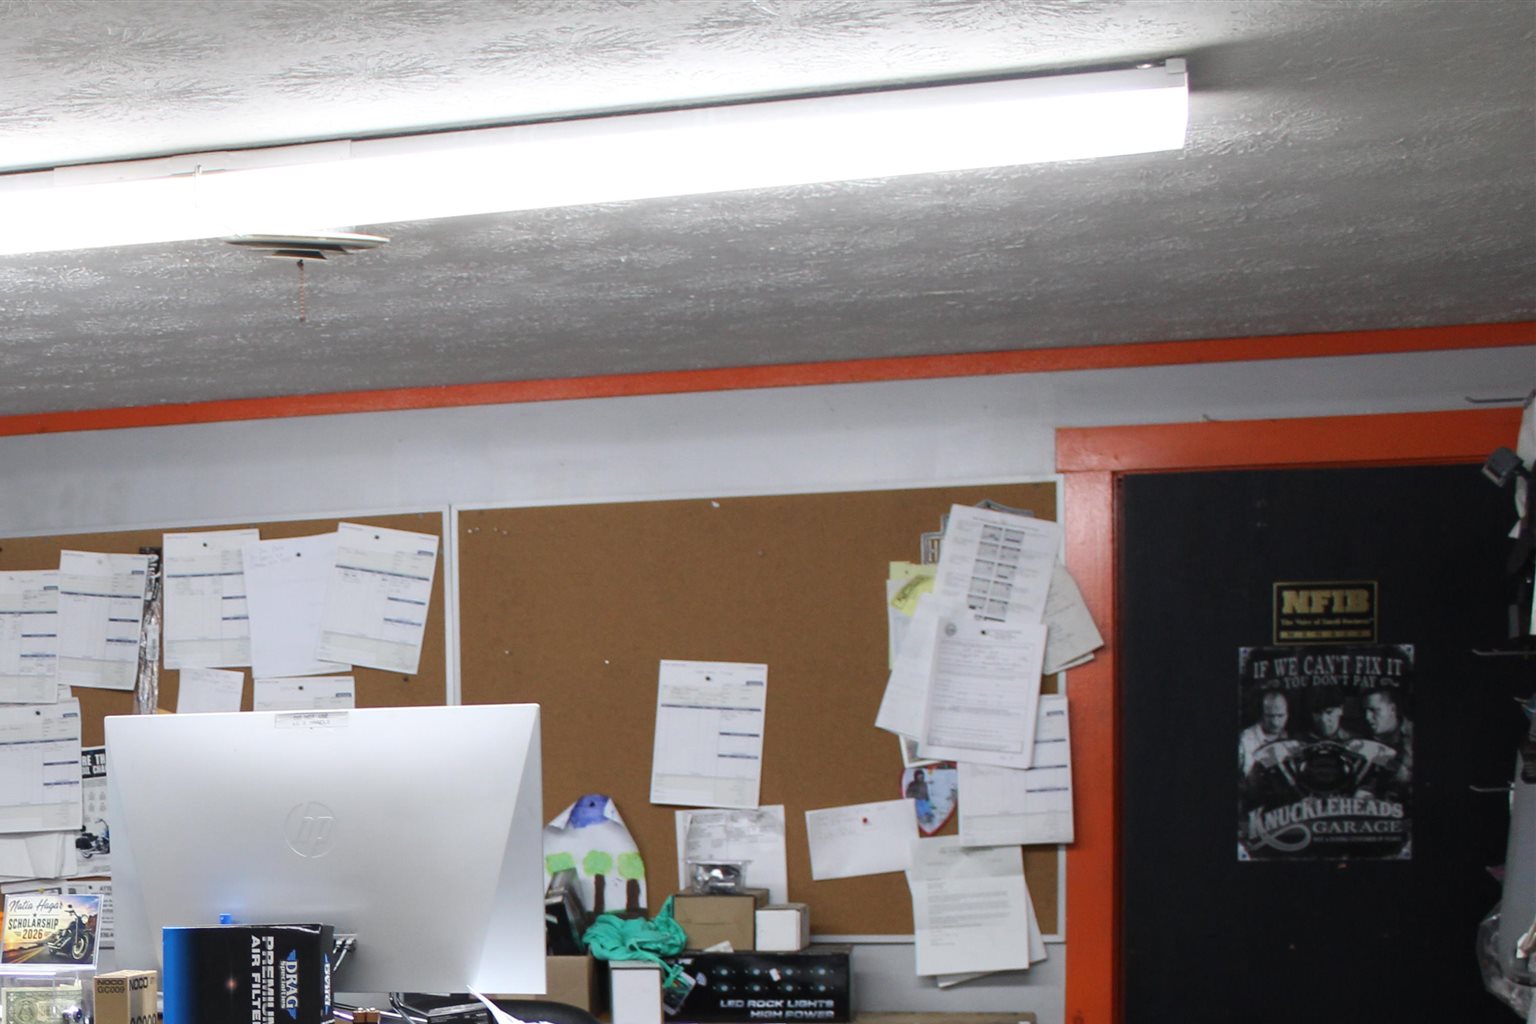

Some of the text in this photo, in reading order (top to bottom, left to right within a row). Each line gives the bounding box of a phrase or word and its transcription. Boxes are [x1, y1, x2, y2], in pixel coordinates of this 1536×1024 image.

[1282, 589, 1370, 614] NFIB
[1253, 655, 1403, 679] IF WE CAN'T FIX IT
[1284, 675, 1378, 689] YOU DON'T PAY
[1248, 797, 1404, 840] KNUCKLEHEADS
[1313, 821, 1402, 833] GARAGE
[8, 918, 59, 930] SCHOLARSHIP
[22, 929, 43, 939] 2026
[251, 935, 261, 966] AIR
[129, 977, 148, 990] NOCO
[286, 961, 298, 1008] DRAG
[720, 1000, 834, 1008] LED ROCK LIGHTS
[750, 1010, 834, 1018] HIGH POWER
